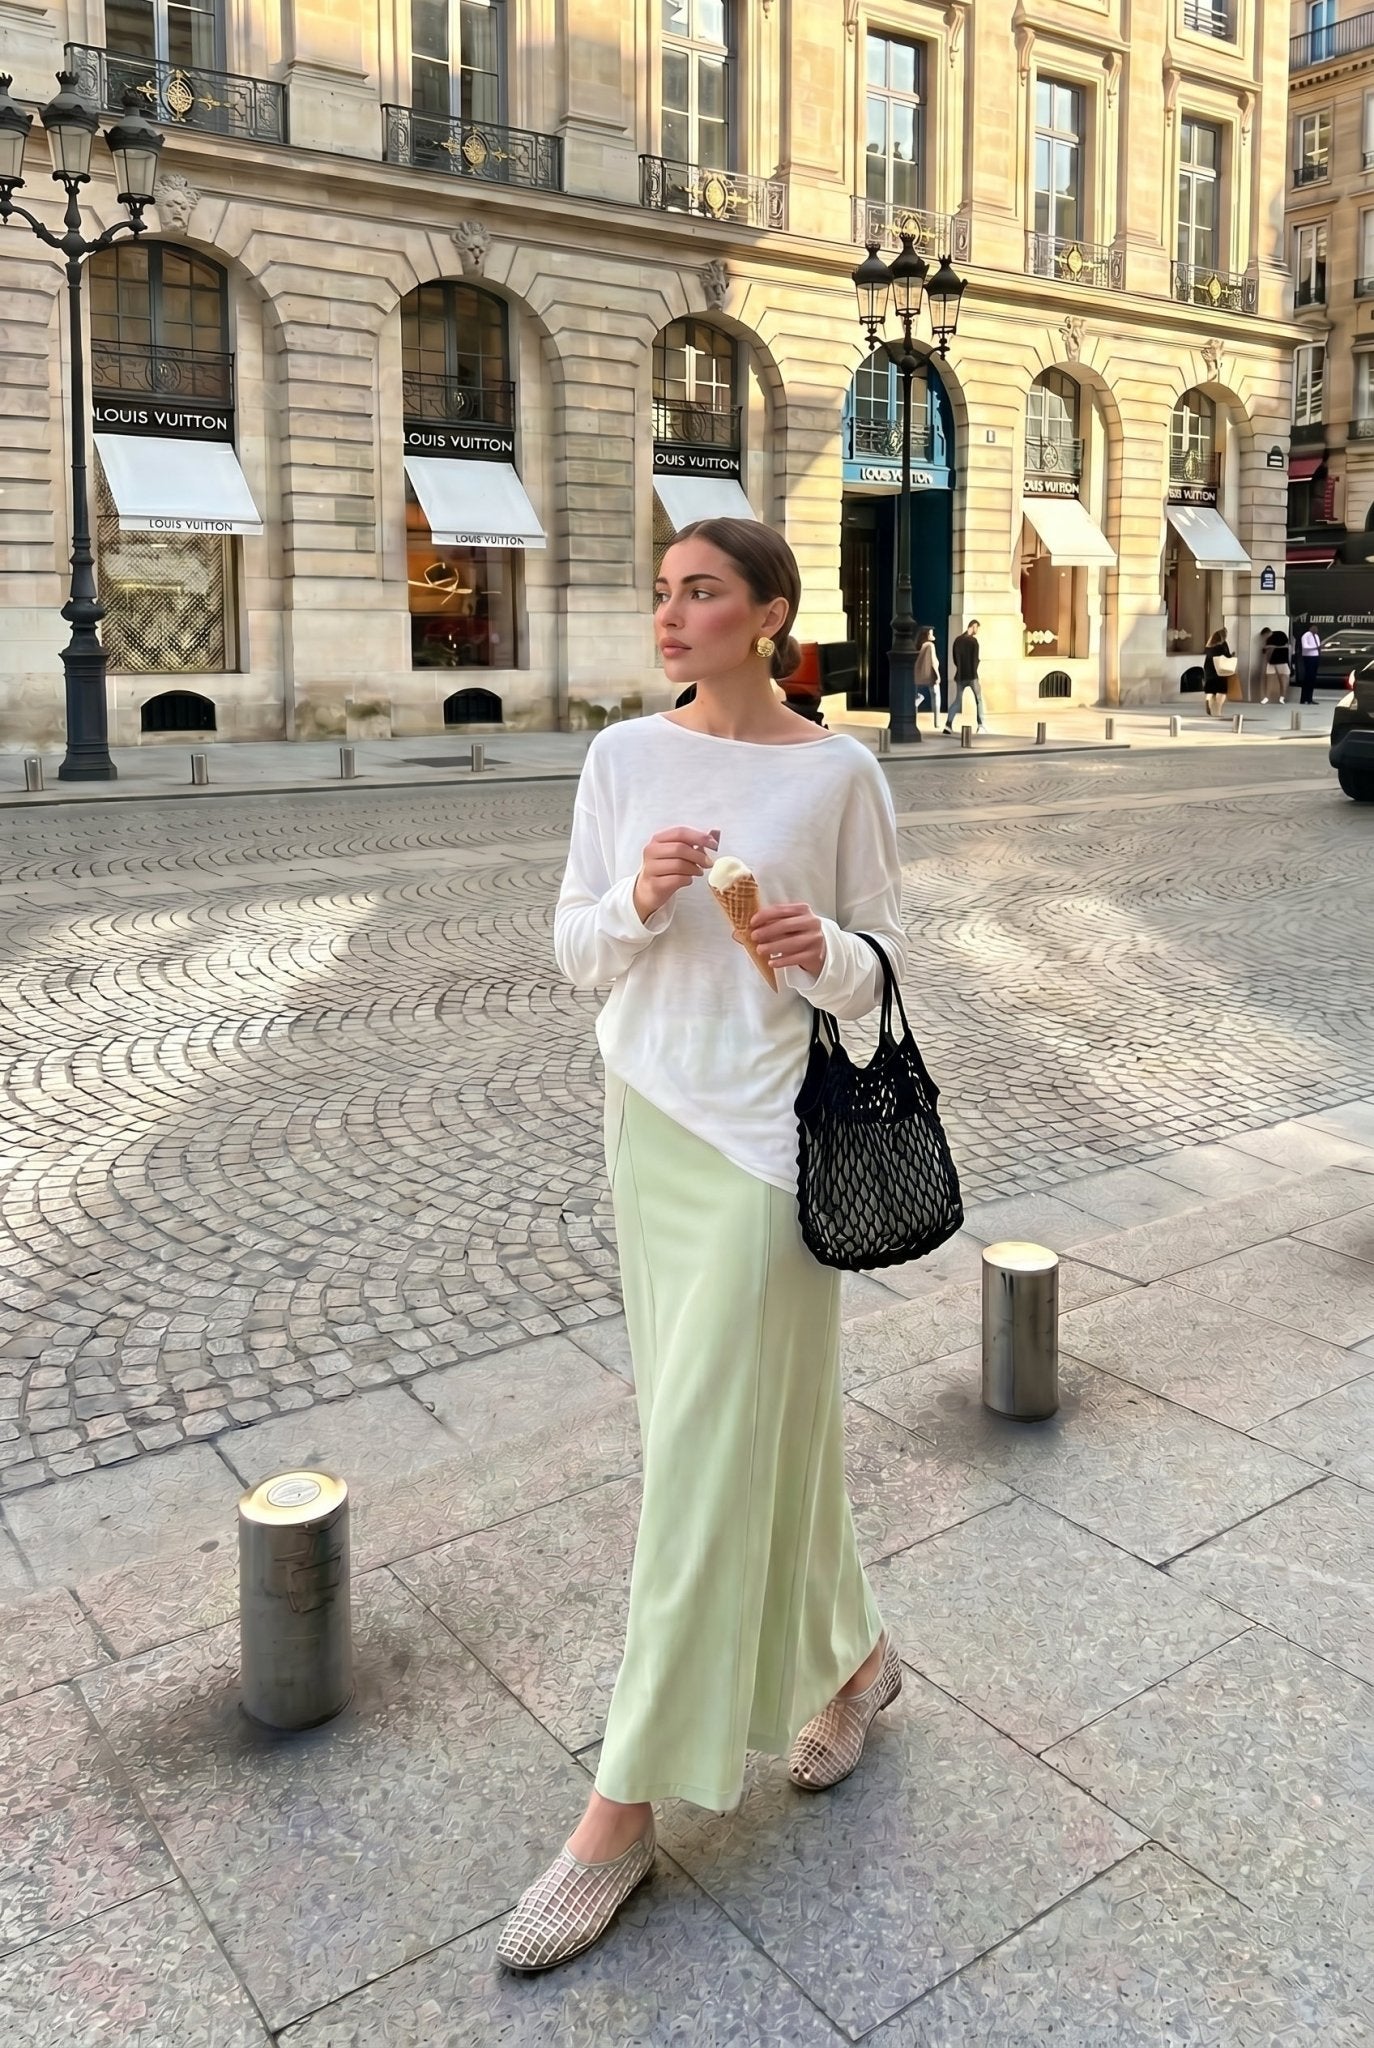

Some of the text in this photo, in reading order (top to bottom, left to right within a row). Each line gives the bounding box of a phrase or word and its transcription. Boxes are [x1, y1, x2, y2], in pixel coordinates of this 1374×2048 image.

[96, 407, 227, 430] LOUIS VUITTON
[450, 435, 513, 452] VUITTON
[654, 453, 739, 471] OUIS VUITTON
[1023, 480, 1043, 492] OUIS
[149, 519, 233, 531] LOUIS VUITTON
[455, 535, 524, 545] LOUIS VUITTON
